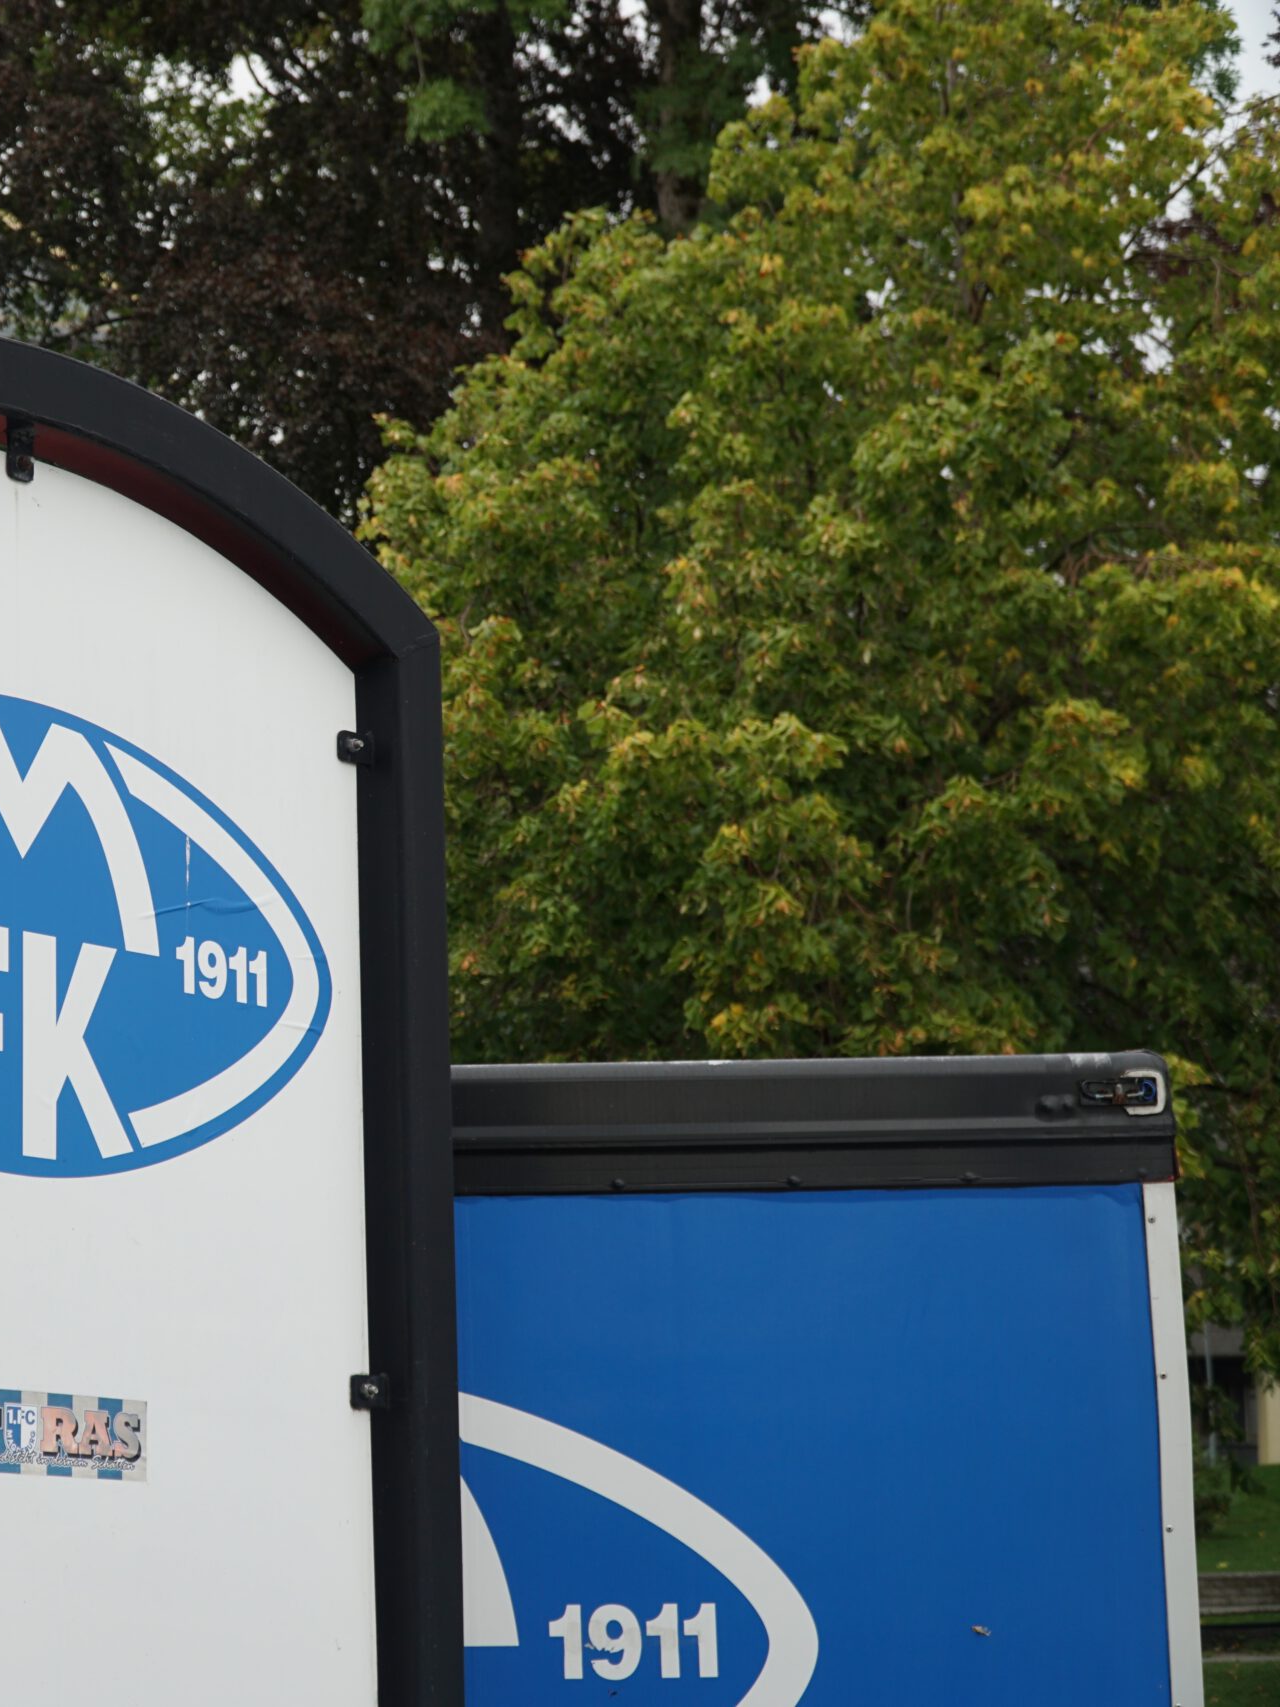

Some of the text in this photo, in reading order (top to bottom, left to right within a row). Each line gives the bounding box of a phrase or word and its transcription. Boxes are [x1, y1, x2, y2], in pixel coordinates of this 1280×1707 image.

[175, 936, 268, 1008] 1911
[91, 1455, 135, 1471] Schatten
[548, 1602, 719, 1681] 1911
